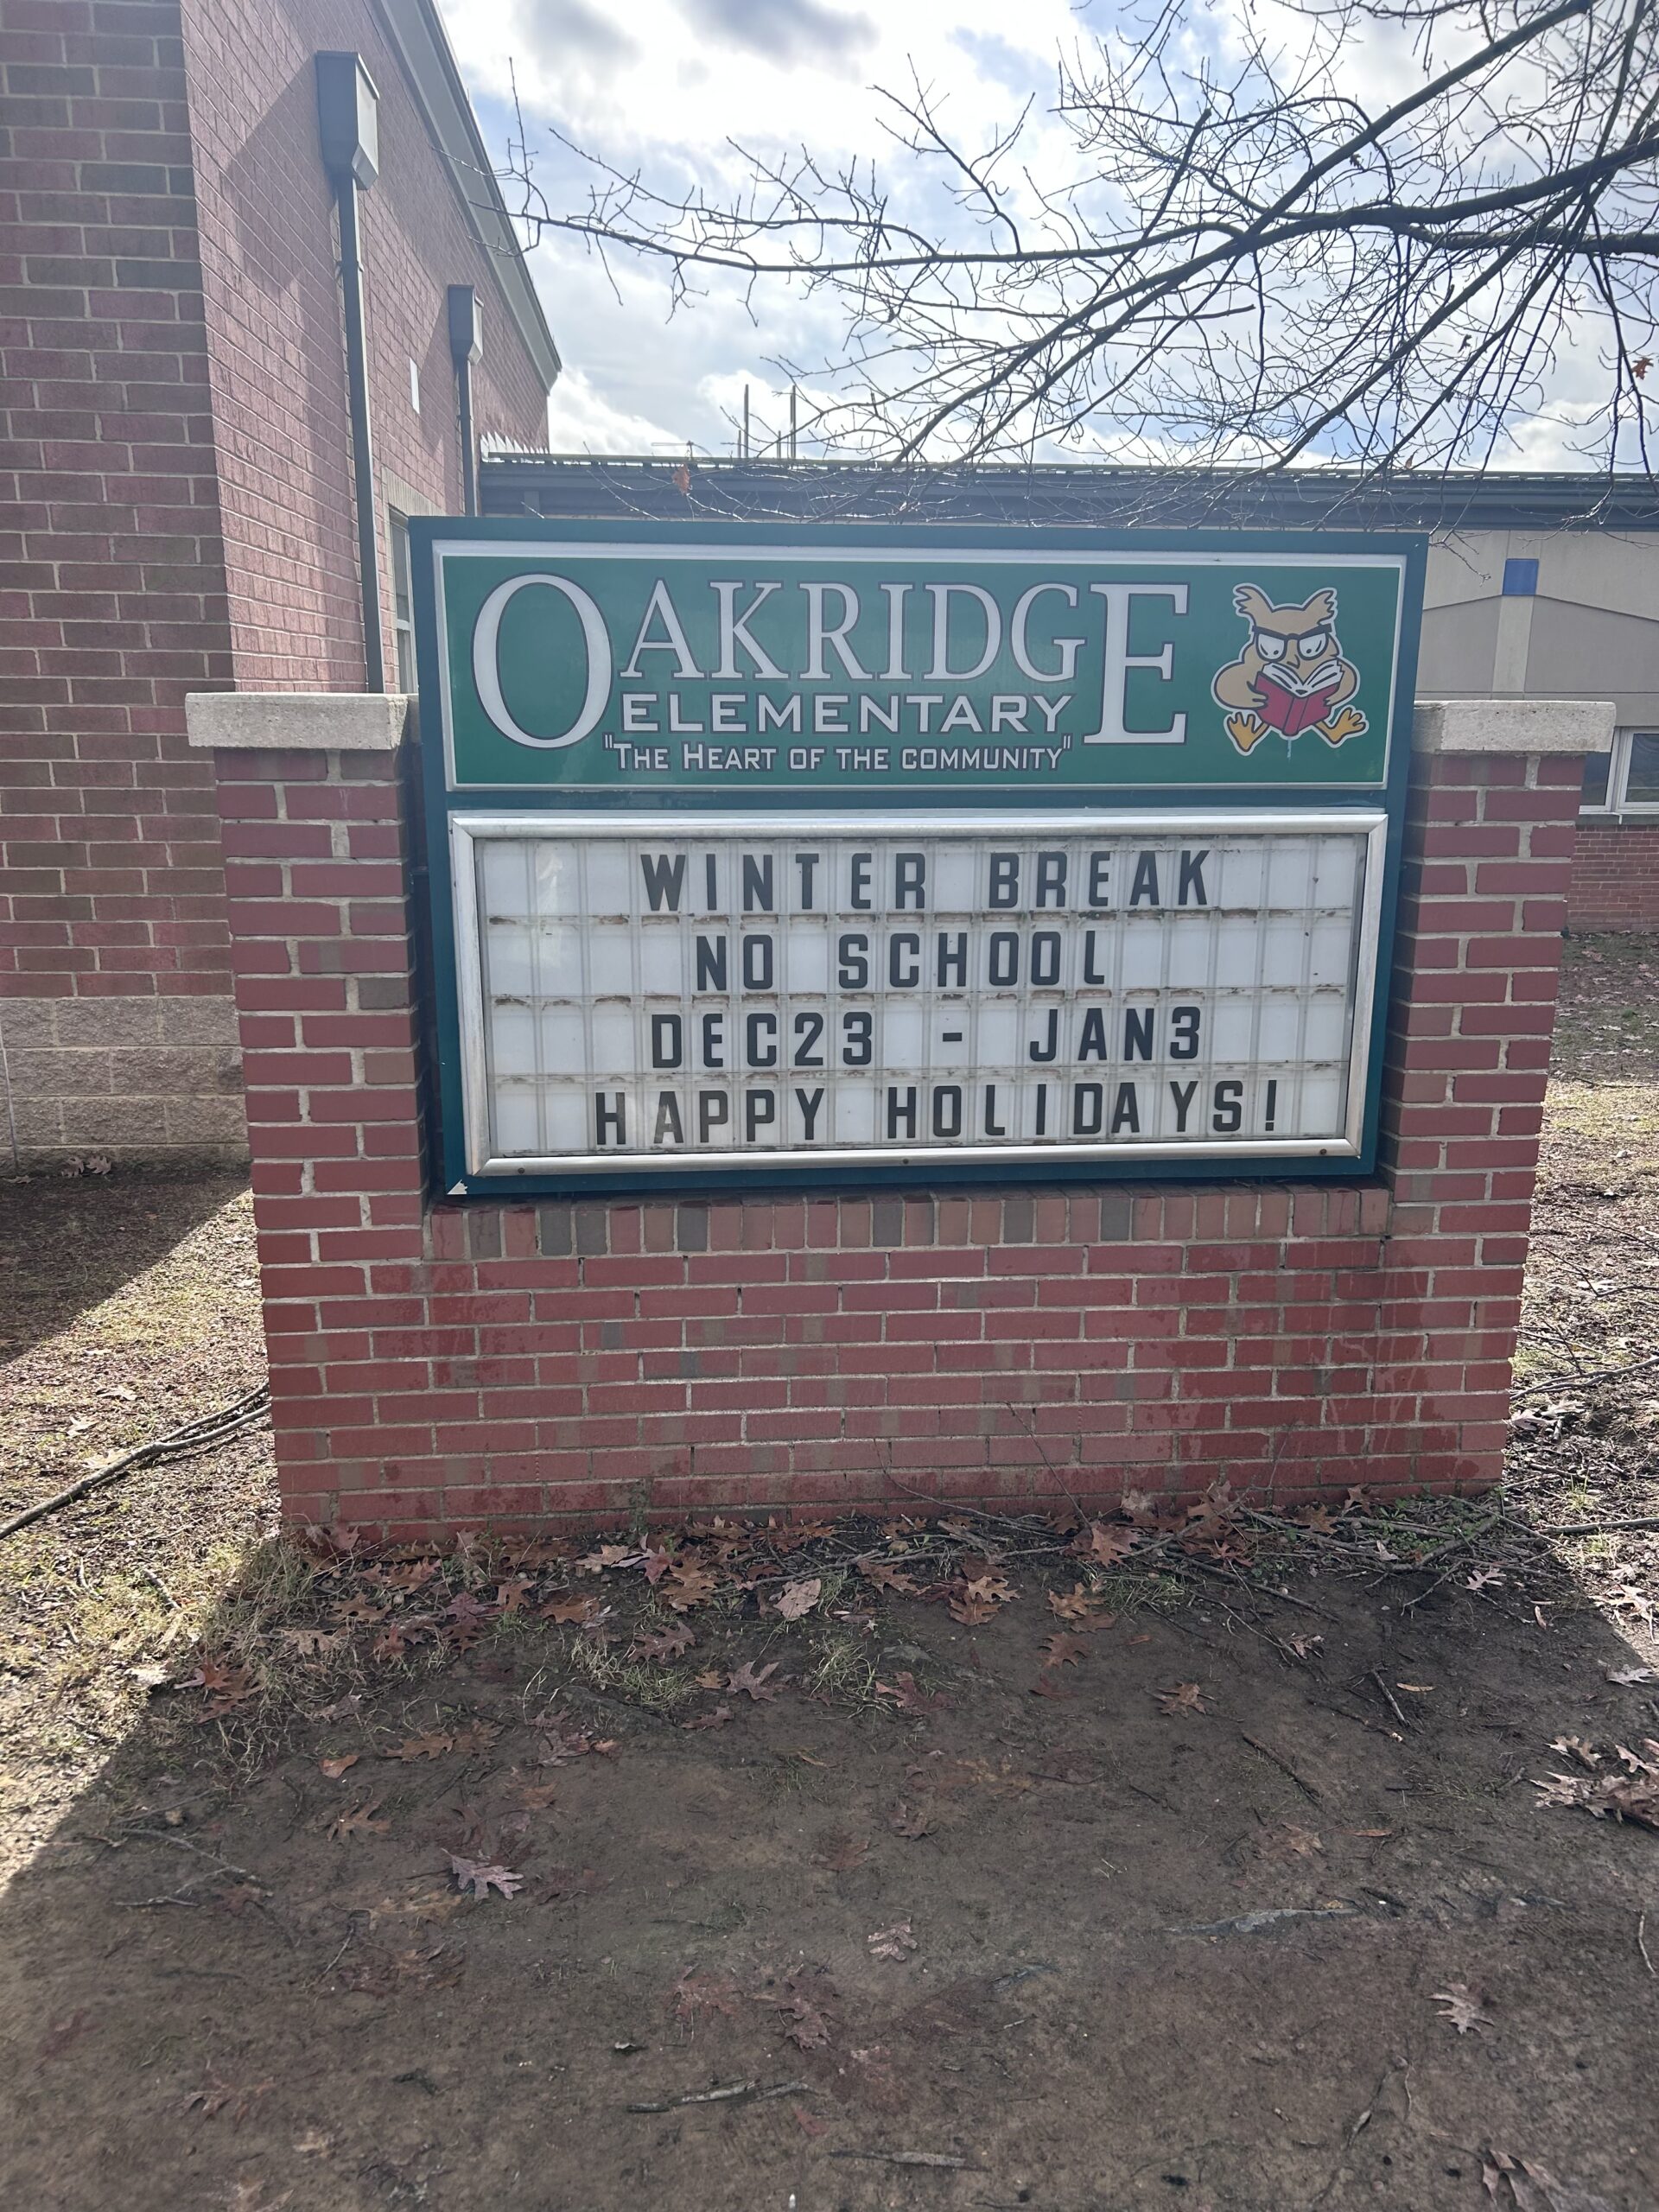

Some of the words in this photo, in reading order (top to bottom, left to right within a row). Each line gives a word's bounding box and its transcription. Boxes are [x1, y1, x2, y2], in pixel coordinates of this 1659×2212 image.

[473, 574, 1188, 748] OAKRIDGE
[622, 694, 1071, 733] ELEMENTARY
[683, 743, 776, 770] HEART
[789, 747, 825, 769] OF
[836, 747, 889, 769] THE
[640, 852, 925, 911] WINTER
[989, 850, 1210, 908] BREAK
[696, 934, 773, 991] NO
[839, 931, 1104, 988] SCHOOL
[652, 1012, 872, 1068] DEC23
[1029, 1007, 1200, 1062] JAN3
[595, 1088, 824, 1145] HAPPY
[887, 1080, 1276, 1139] HOLIDAYS!
